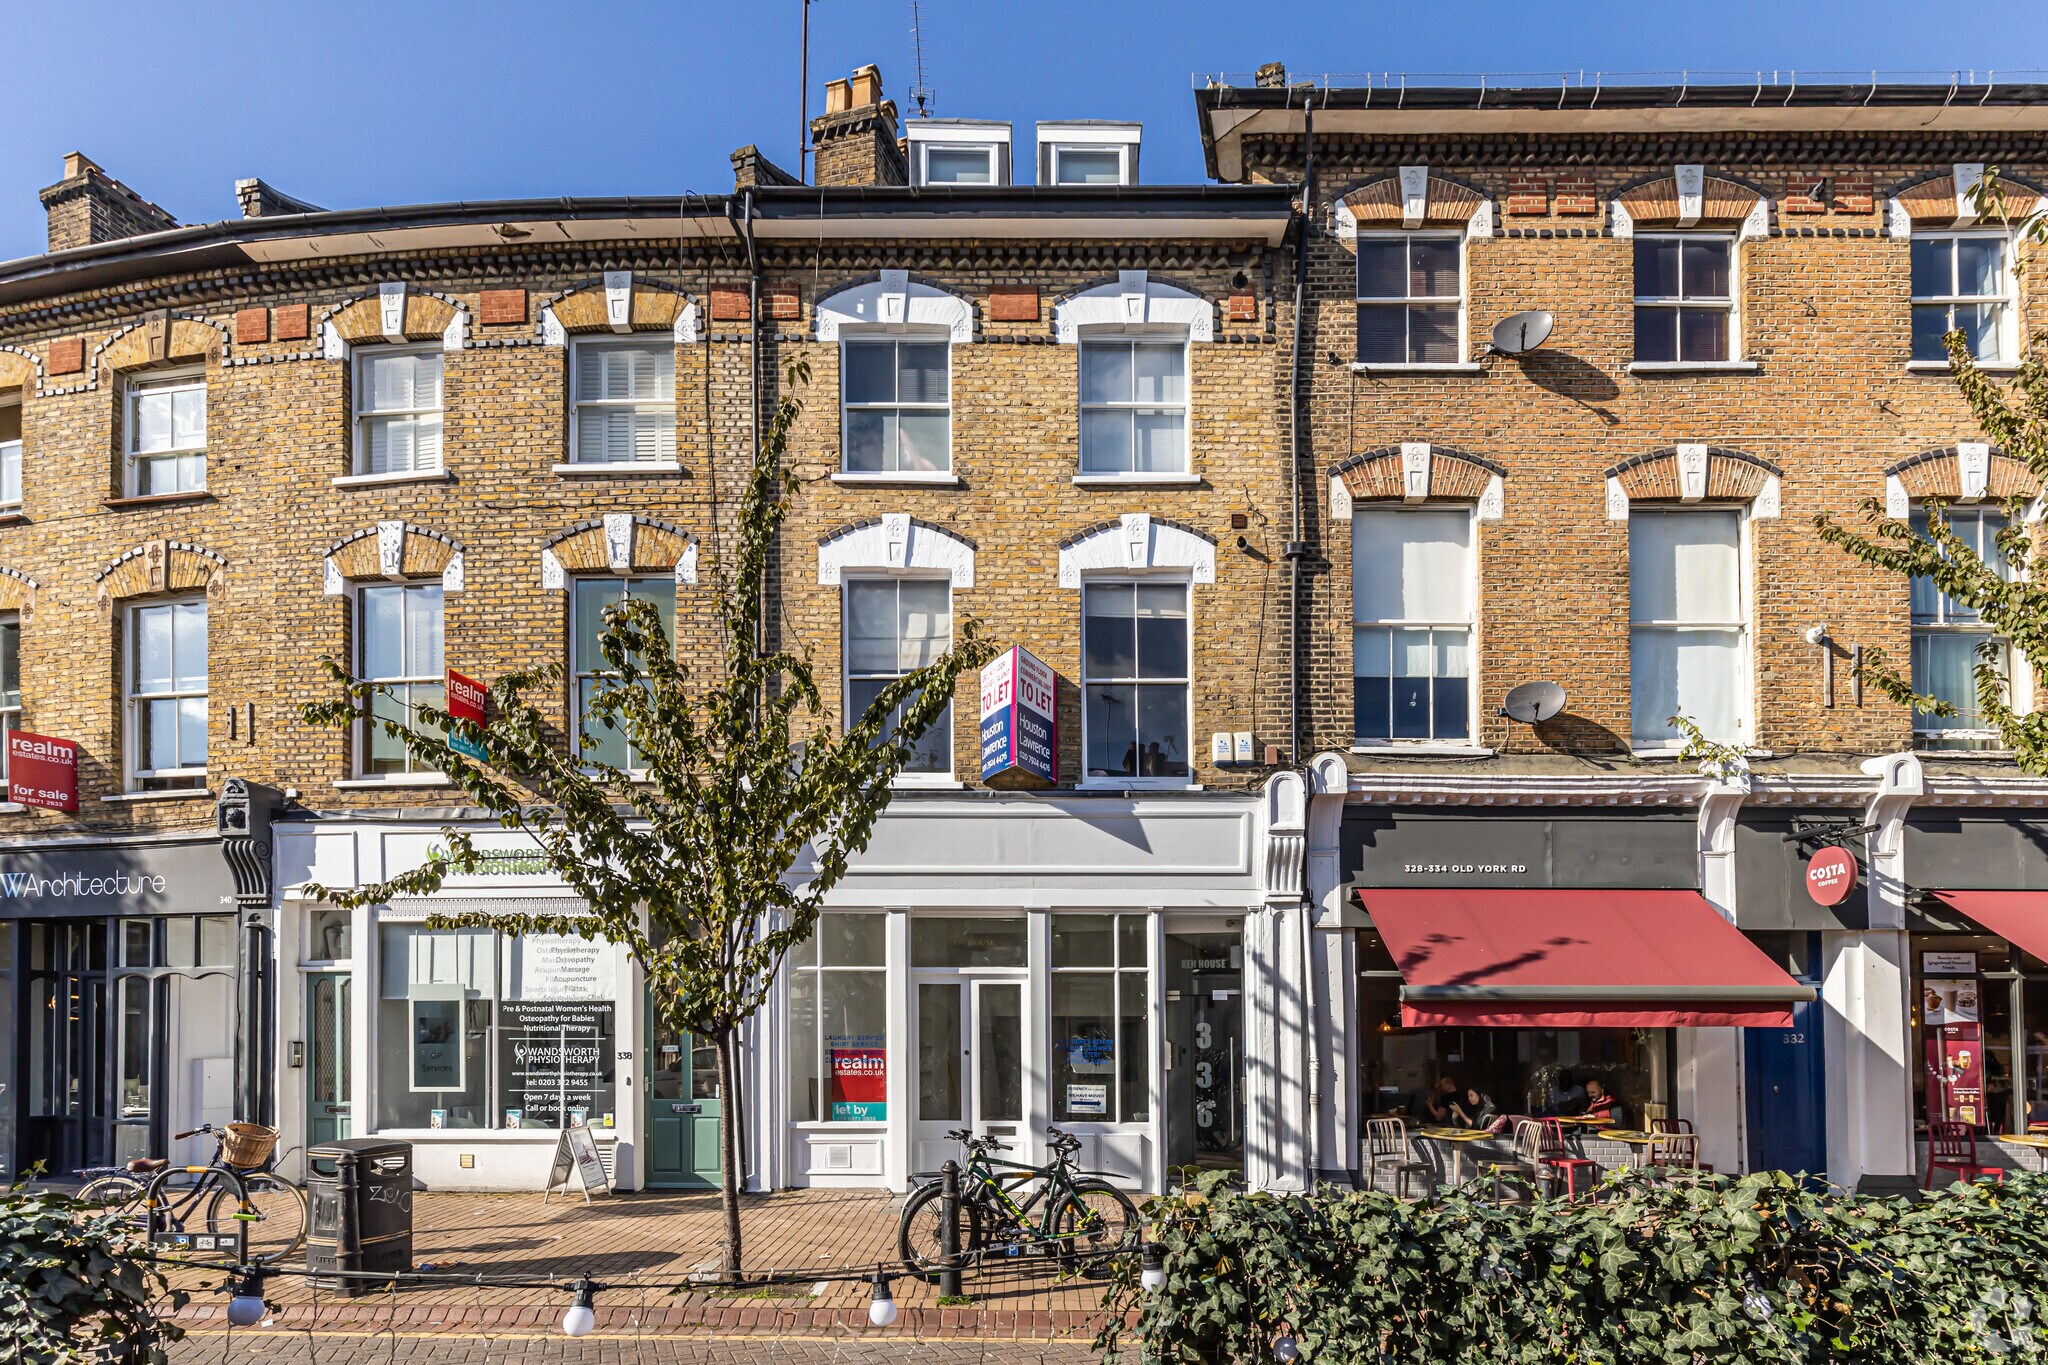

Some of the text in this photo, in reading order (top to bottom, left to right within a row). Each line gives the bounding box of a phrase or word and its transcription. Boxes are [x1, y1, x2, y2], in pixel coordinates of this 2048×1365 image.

[450, 678, 485, 705] realm
[983, 679, 1010, 713] TO LET
[1020, 677, 1052, 714] TO LET
[450, 691, 484, 711] estates.co.uk
[982, 720, 1004, 743] Houston
[1019, 712, 1047, 740] Houston
[12, 738, 73, 759] realm
[982, 736, 1007, 760] Lawrence
[1019, 730, 1050, 759] Lawrence
[12, 750, 73, 766] estates.co.uk
[13, 784, 68, 801] for sale
[1404, 864, 1527, 873] 328-334 OLD YORK RD
[1809, 863, 1846, 880] COSTA
[0, 869, 166, 898] WArchitecture
[1817, 878, 1839, 887] COFFEE
[219, 896, 232, 904] 340
[1181, 958, 1226, 969] KEN HOUSE
[519, 1015, 559, 1023] Osteopathy
[561, 1025, 591, 1033] Therapy
[1783, 1033, 1805, 1044] 332
[431, 1052, 443, 1060] GP
[528, 1047, 600, 1056] WANDSWORTH
[617, 1052, 632, 1060] 338
[834, 1054, 885, 1069] realm
[421, 1064, 453, 1073] Services
[523, 1094, 543, 1102] Open
[525, 1104, 539, 1112] Call
[548, 1104, 567, 1112] book
[567, 1104, 590, 1112] online
[836, 1104, 868, 1115] let by
[315, 1255, 337, 1265] LITTE
